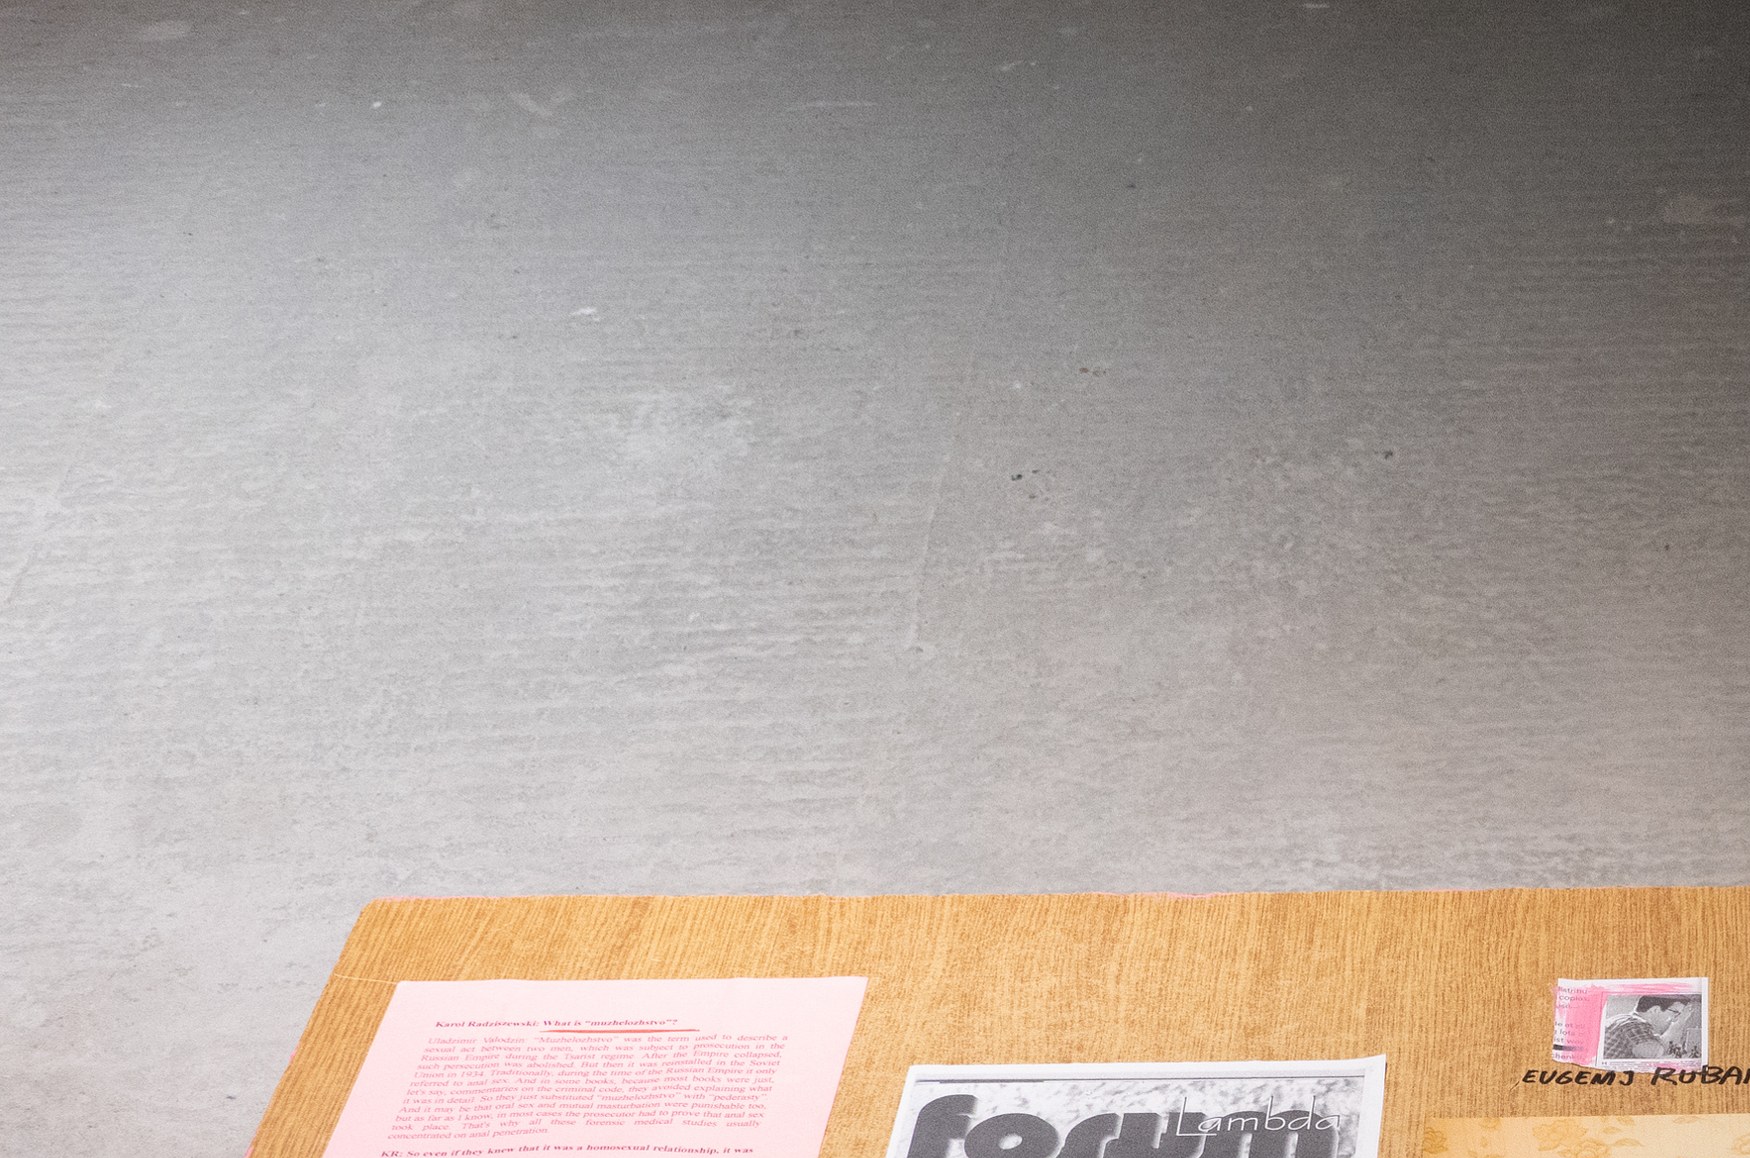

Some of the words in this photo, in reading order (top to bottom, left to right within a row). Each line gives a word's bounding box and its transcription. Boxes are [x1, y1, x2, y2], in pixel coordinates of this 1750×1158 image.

[434, 1020, 465, 1028] Karol
[542, 1019, 571, 1027] What
[573, 1019, 581, 1027] is
[1175, 1095, 1341, 1137] Lambda
[575, 1144, 583, 1152] a
[586, 1143, 650, 1151] homosexual
